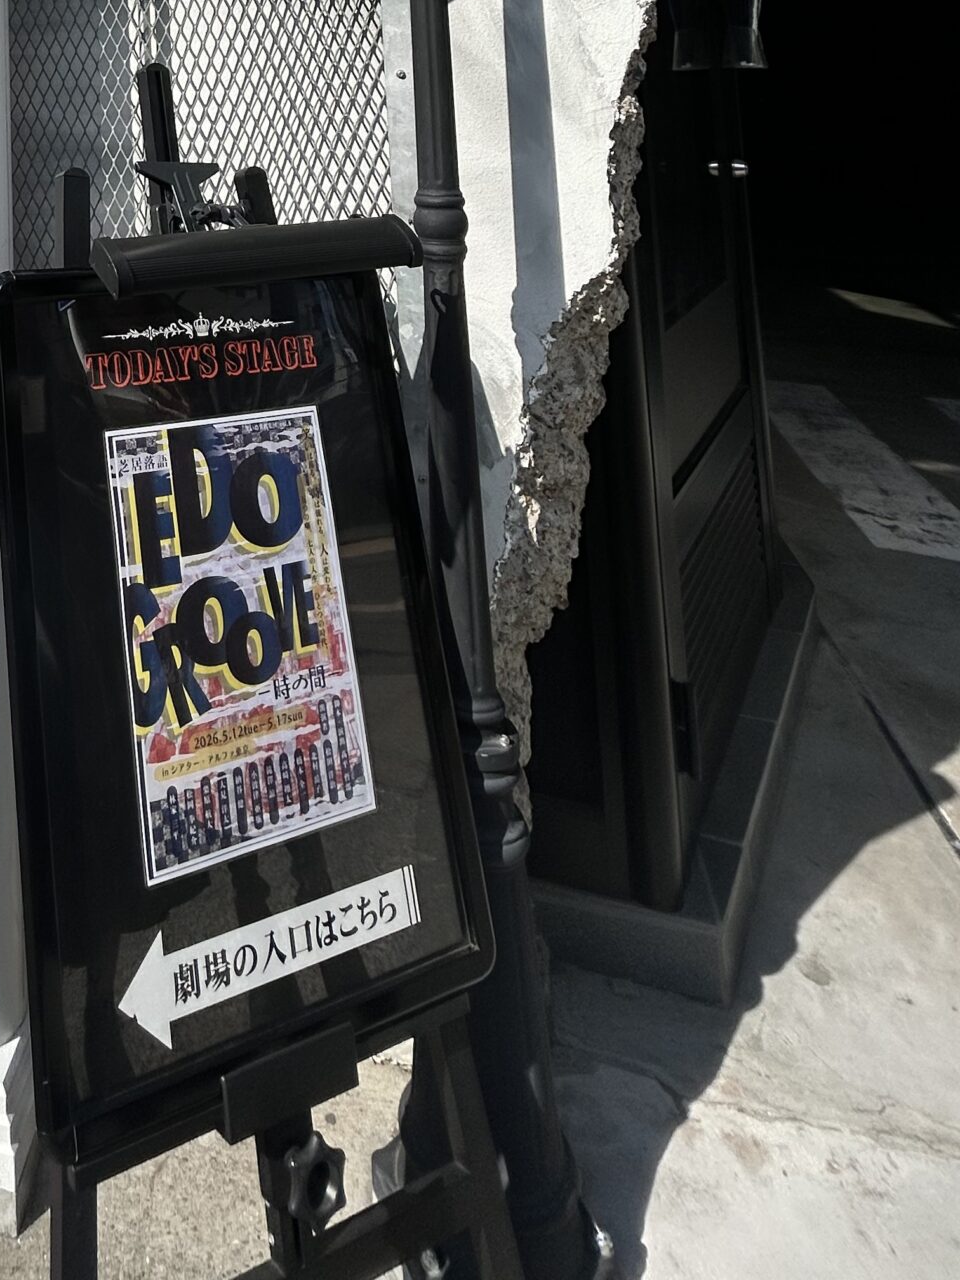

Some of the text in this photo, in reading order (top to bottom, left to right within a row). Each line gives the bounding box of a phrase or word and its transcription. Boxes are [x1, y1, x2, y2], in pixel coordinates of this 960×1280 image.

[86, 334, 318, 390] TODAY'S STAGE
[119, 456, 168, 473] 芝居落語
[132, 424, 304, 588] EDO
[120, 560, 320, 730] GROOVE
[172, 890, 398, 1006] 劇場の入口はこちら
